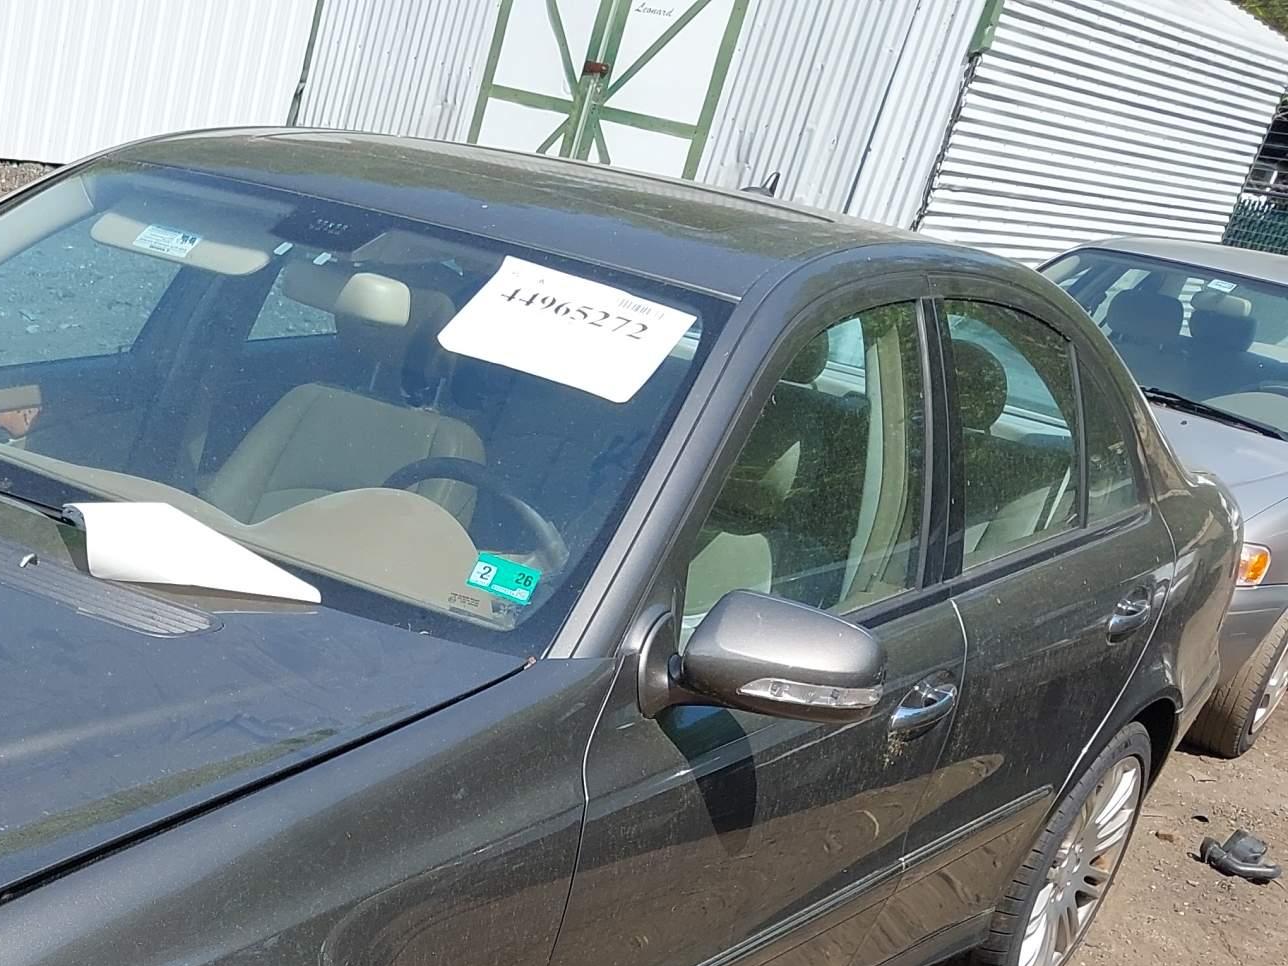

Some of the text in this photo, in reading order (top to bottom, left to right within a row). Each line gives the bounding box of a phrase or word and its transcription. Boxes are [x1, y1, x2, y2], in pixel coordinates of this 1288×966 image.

[501, 288, 649, 340] 44965272
[479, 565, 534, 588] 2 26
